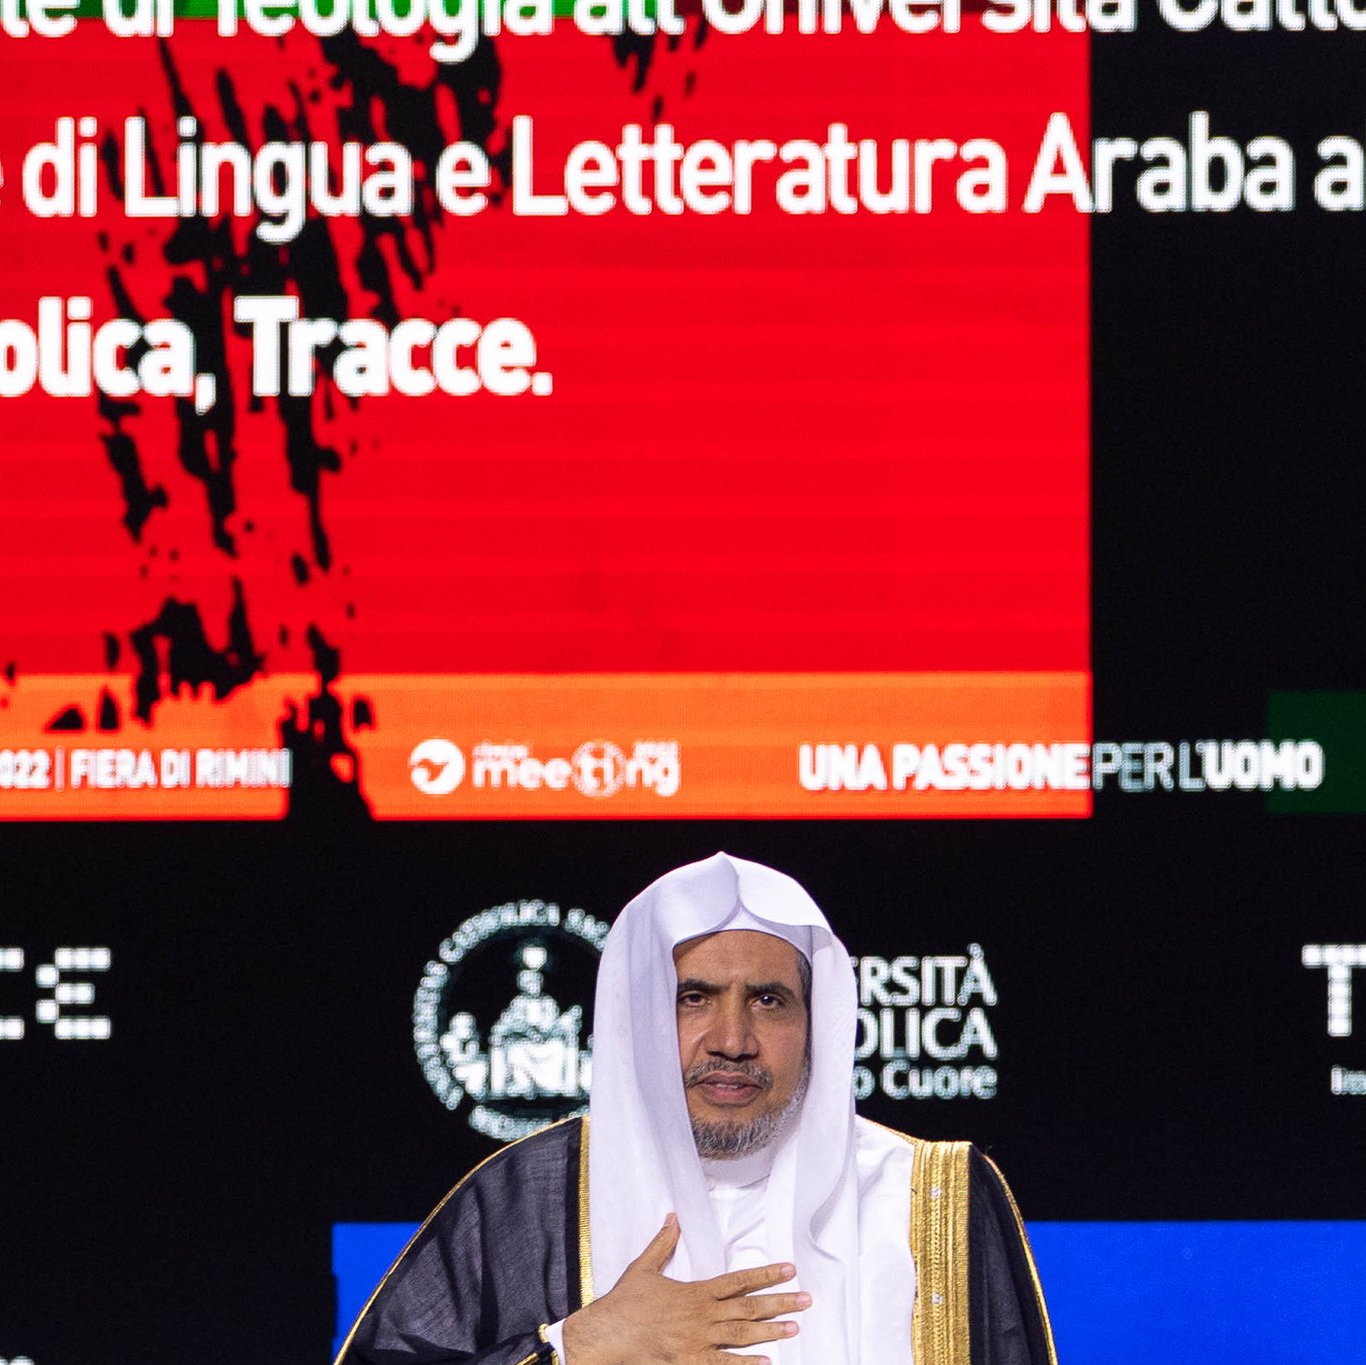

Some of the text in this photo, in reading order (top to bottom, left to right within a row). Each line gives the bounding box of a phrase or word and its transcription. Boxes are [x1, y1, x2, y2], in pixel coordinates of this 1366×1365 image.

[22, 116, 97, 217] di
[125, 115, 412, 244] Lingua
[436, 141, 491, 217] e
[513, 115, 1007, 217] Letteratura
[1024, 111, 1294, 214] Araba
[234, 296, 553, 398] Tracce.
[70, 748, 158, 789] FIERA
[160, 748, 191, 789] DI
[472, 742, 681, 797] meeting
[798, 743, 888, 791] UNA
[881, 1058, 998, 1100] Cuore
